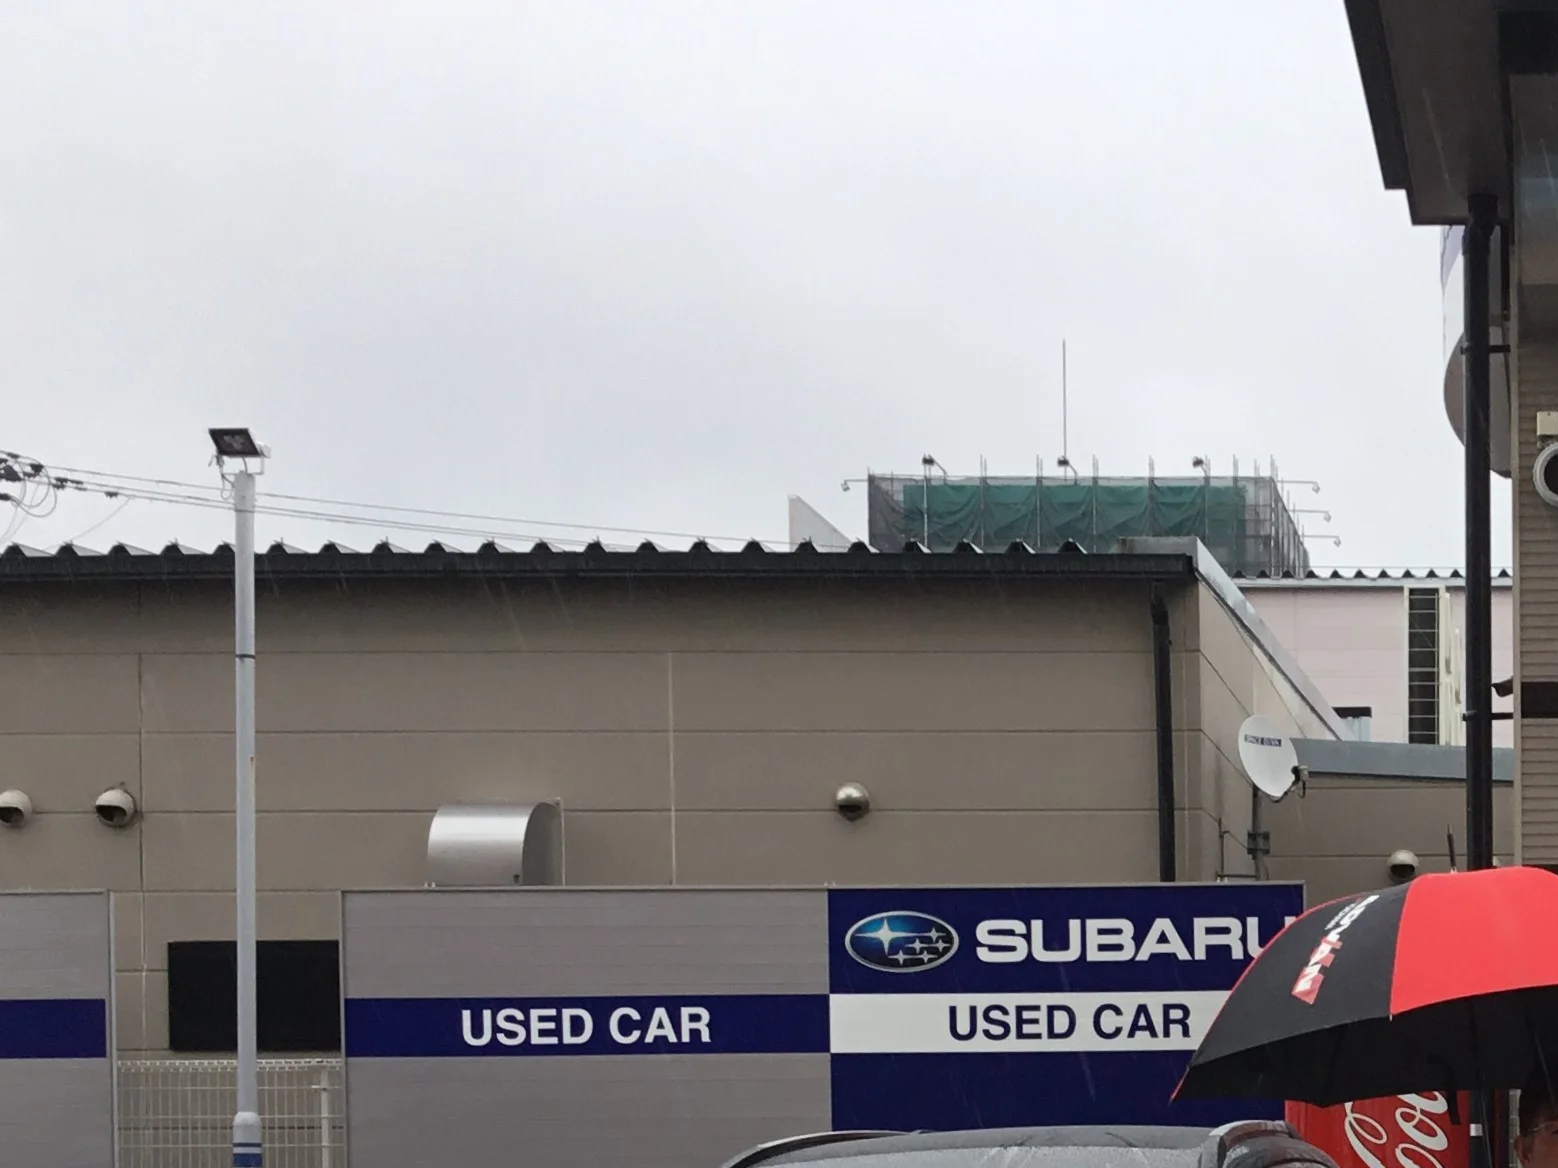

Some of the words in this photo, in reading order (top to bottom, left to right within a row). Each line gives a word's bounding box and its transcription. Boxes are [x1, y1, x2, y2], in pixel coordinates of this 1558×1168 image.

[462, 1007, 594, 1046] USED
[609, 1006, 713, 1045] CAR
[948, 1004, 1076, 1041] USED
[1093, 1004, 1191, 1039] CAR
